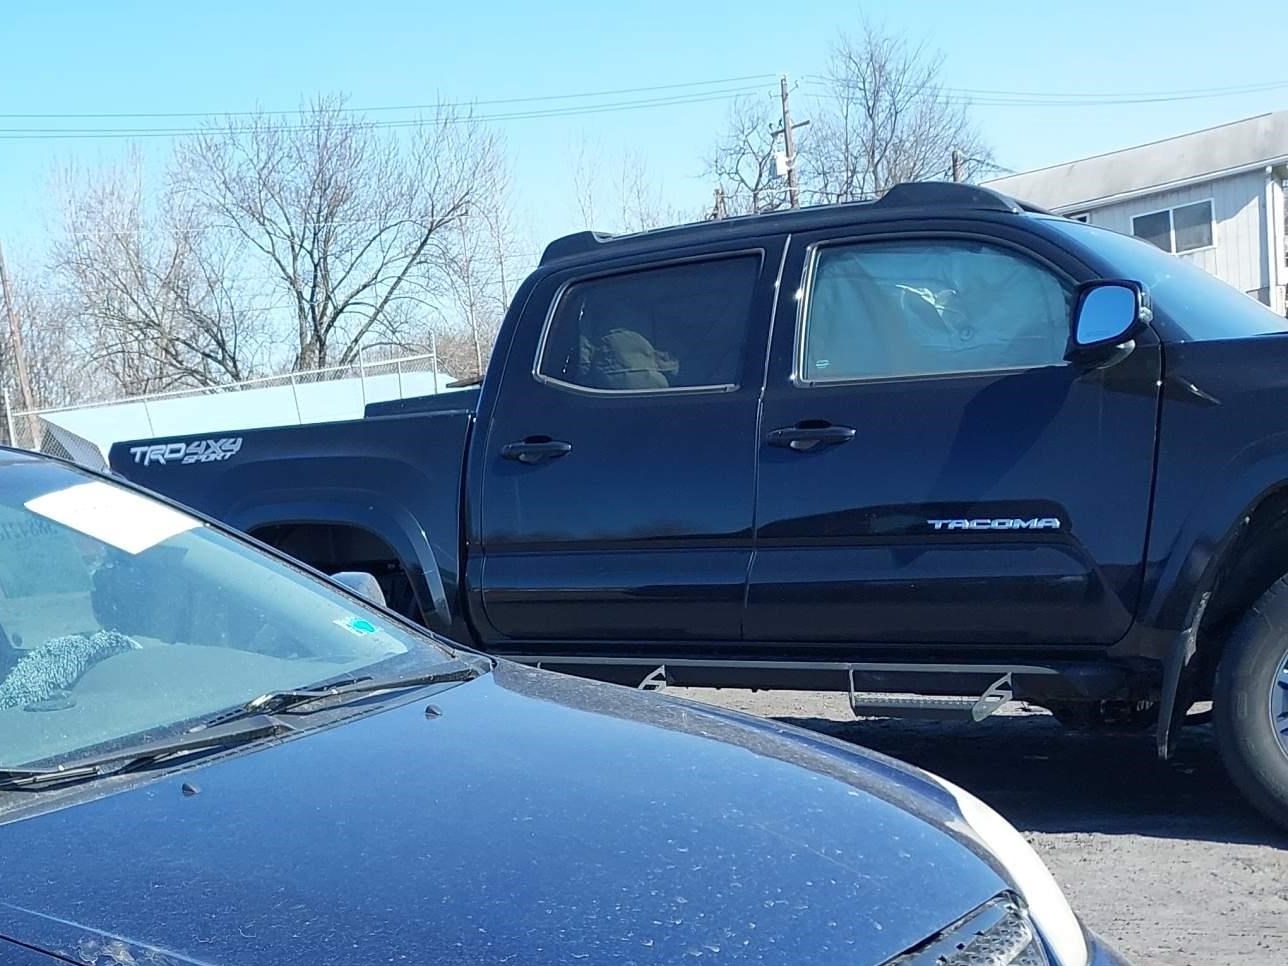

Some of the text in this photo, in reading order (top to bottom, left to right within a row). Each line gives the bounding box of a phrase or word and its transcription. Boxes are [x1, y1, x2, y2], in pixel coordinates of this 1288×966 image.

[130, 443, 186, 466] TRD
[181, 452, 235, 464] SPORT
[927, 518, 1061, 529] TACOMA
